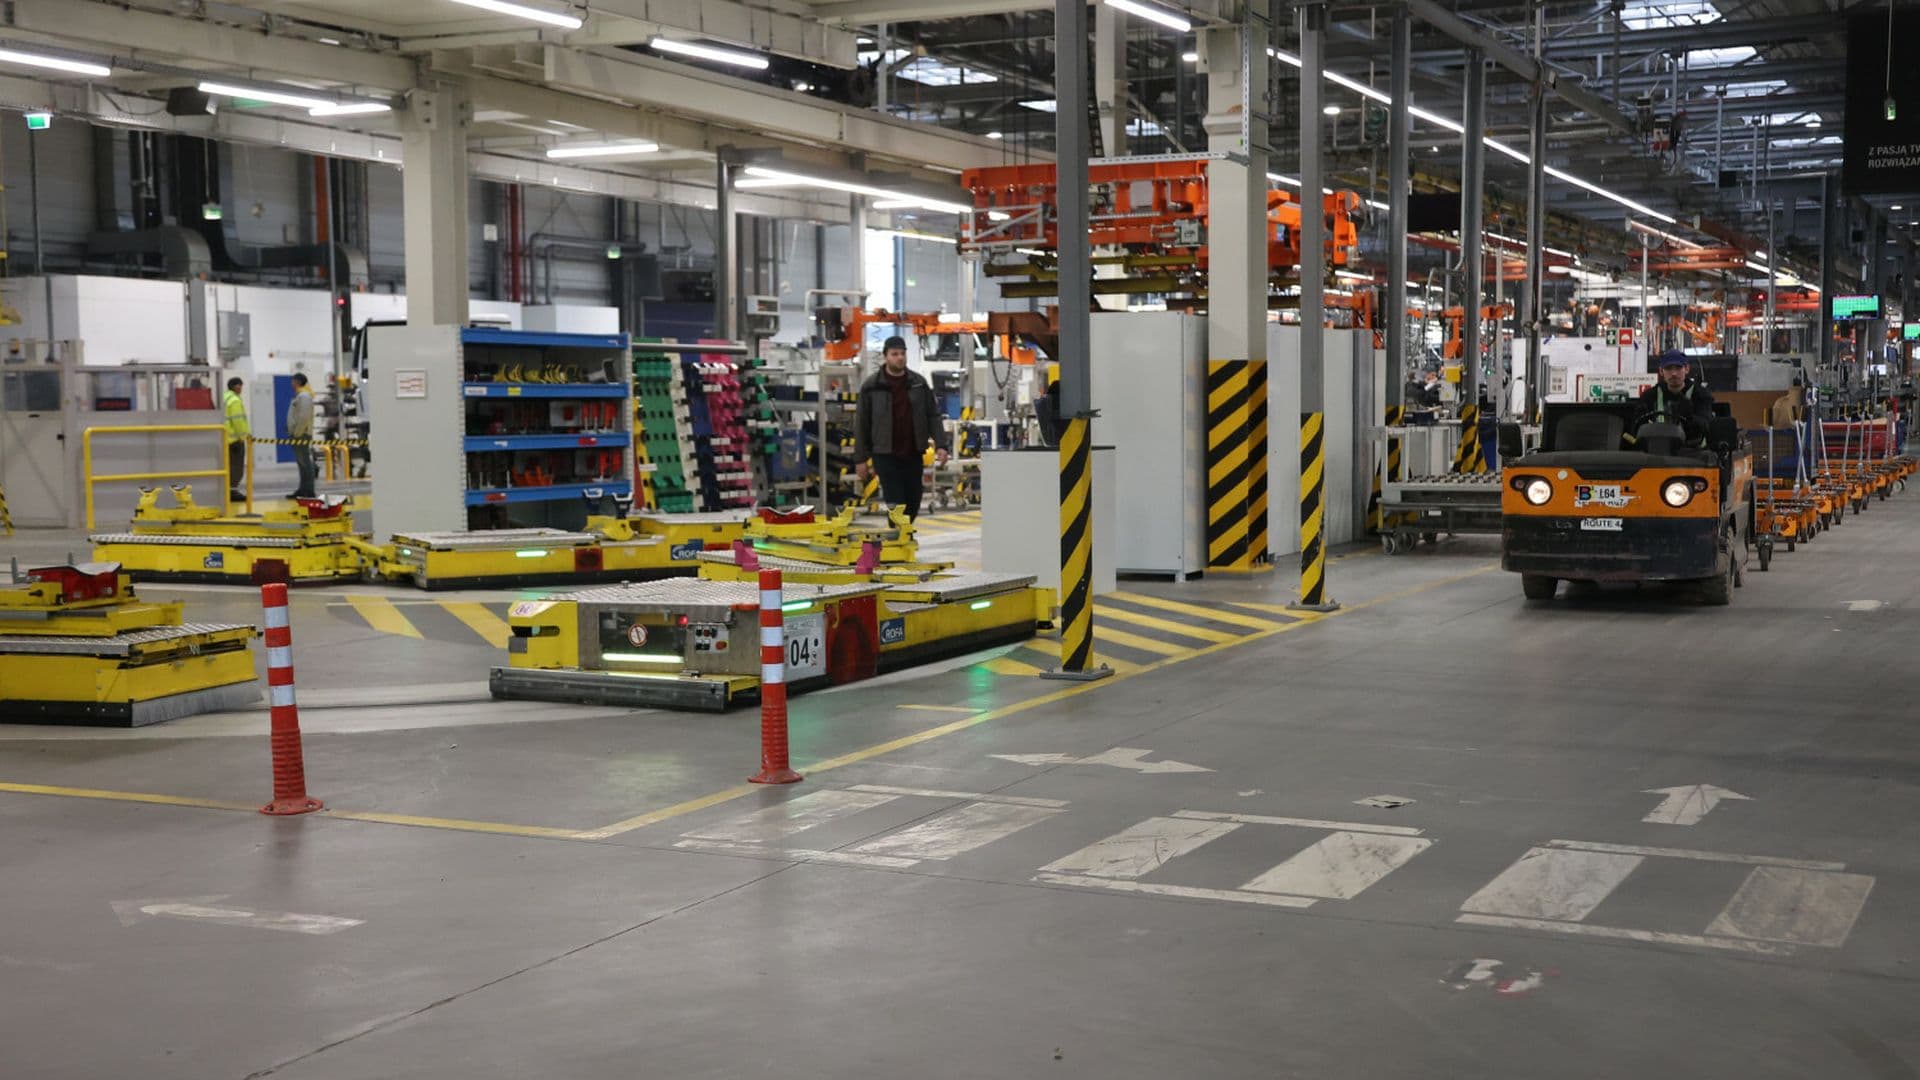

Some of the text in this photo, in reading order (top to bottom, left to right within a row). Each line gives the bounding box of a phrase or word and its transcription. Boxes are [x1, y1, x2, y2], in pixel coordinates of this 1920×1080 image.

[1868, 147, 1874, 156] Z
[1877, 145, 1907, 155] PASJĄ
[1584, 519, 1612, 528] ROUTE
[790, 637, 810, 666] 04
